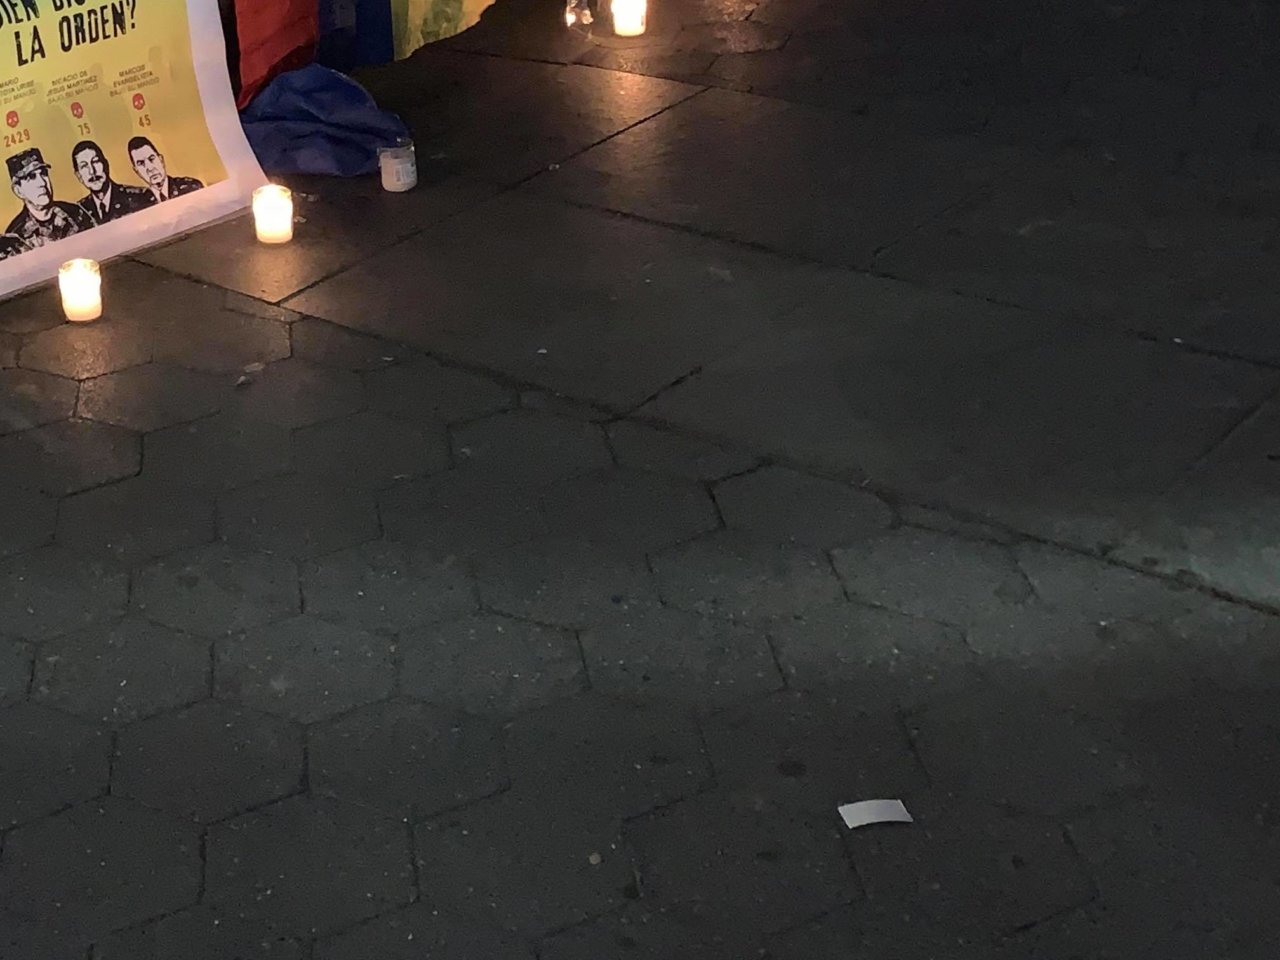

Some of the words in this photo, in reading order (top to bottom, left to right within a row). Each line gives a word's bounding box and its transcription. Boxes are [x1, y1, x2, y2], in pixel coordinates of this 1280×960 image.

[14, 25, 46, 66] LA
[0, 77, 18, 89] MARIO
[138, 114, 151, 128] 45
[77, 122, 91, 136] 75
[3, 128, 30, 147] 2429
